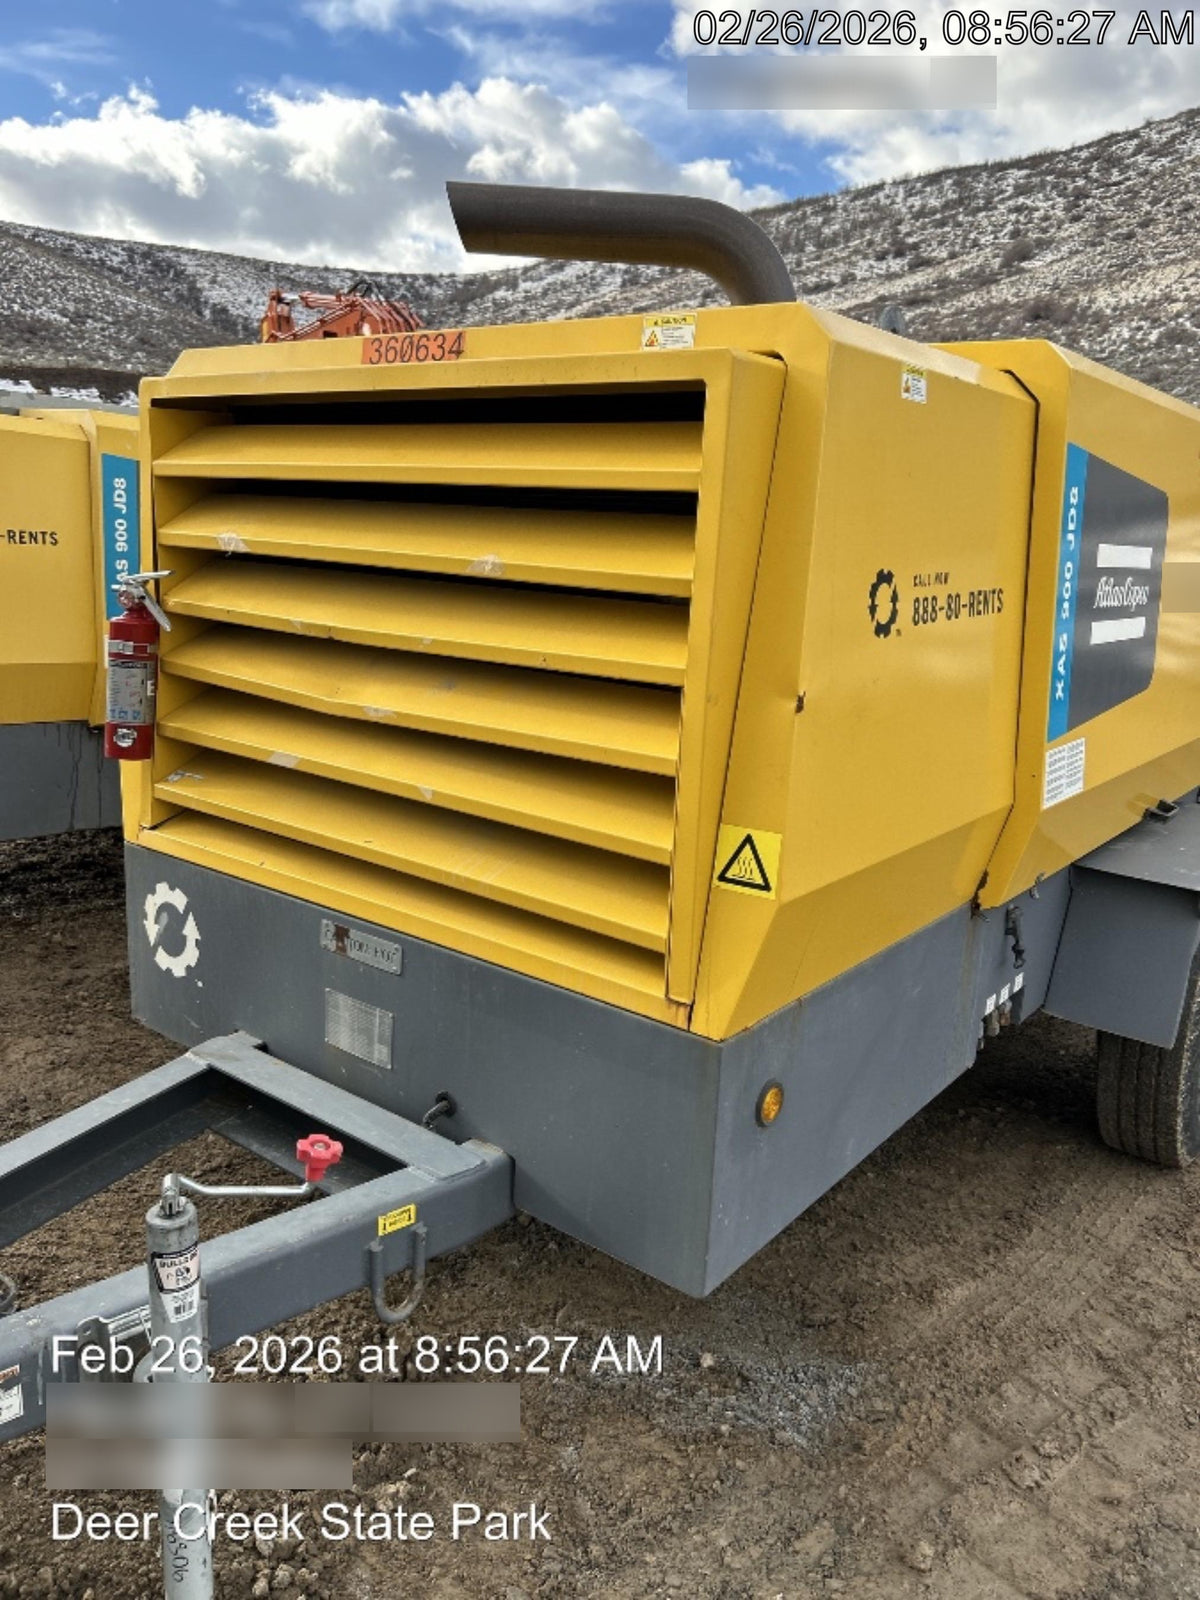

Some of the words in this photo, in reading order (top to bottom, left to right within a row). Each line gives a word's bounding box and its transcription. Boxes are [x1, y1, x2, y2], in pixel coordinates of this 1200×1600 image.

[369, 332, 465, 365] 360634
[112, 477, 127, 515] JD8
[114, 519, 128, 552] 900
[1066, 485, 1079, 551] JD8
[912, 588, 1004, 627] 888-80-RENTS
[1061, 563, 1074, 619] 900
[1055, 632, 1068, 702] XAS
